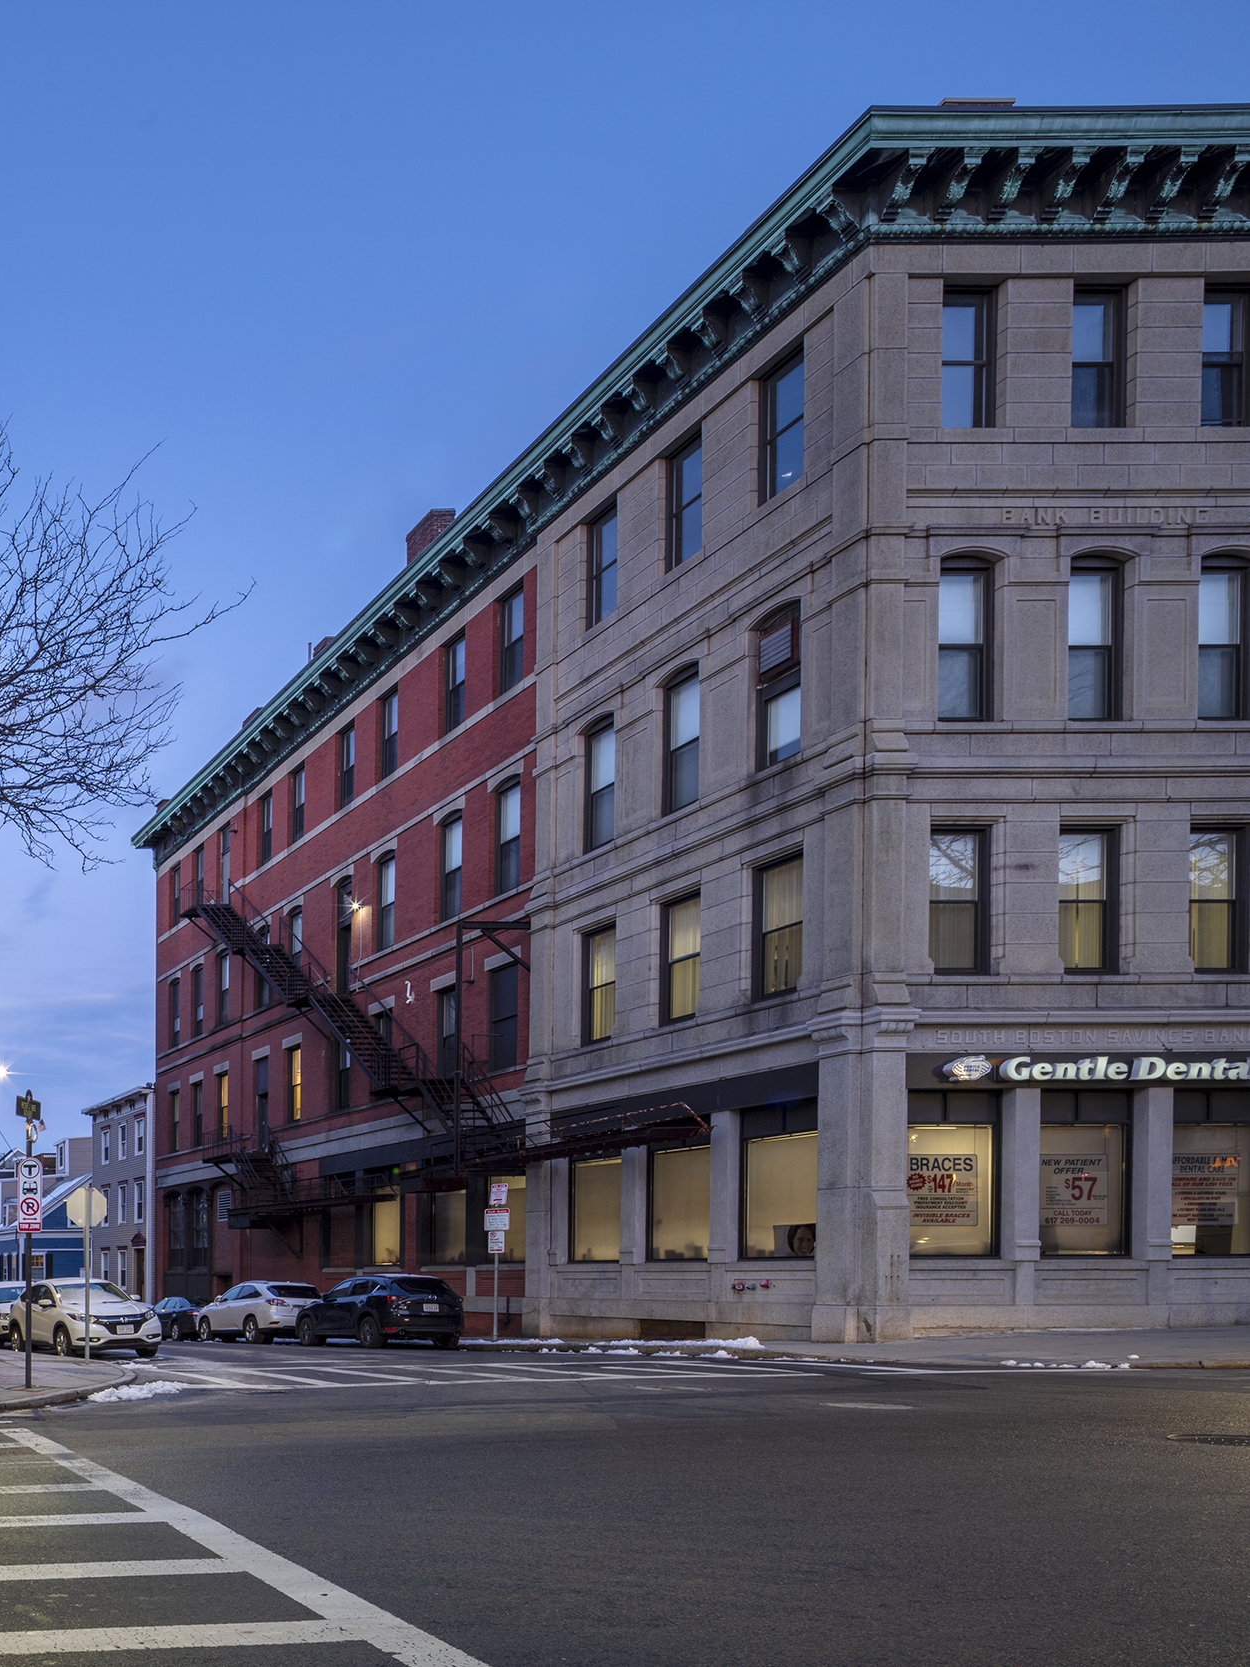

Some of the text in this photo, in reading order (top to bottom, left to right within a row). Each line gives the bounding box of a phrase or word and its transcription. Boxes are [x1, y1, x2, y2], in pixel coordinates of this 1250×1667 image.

[1002, 508, 1209, 525] BANK BUILDING
[936, 1029, 1250, 1044] SOUTH BOSTON SAVINGS BAN
[1004, 1056, 1250, 1081] Gentle Denta
[910, 1158, 973, 1171] BRACES
[1064, 1177, 1098, 1200] $57
